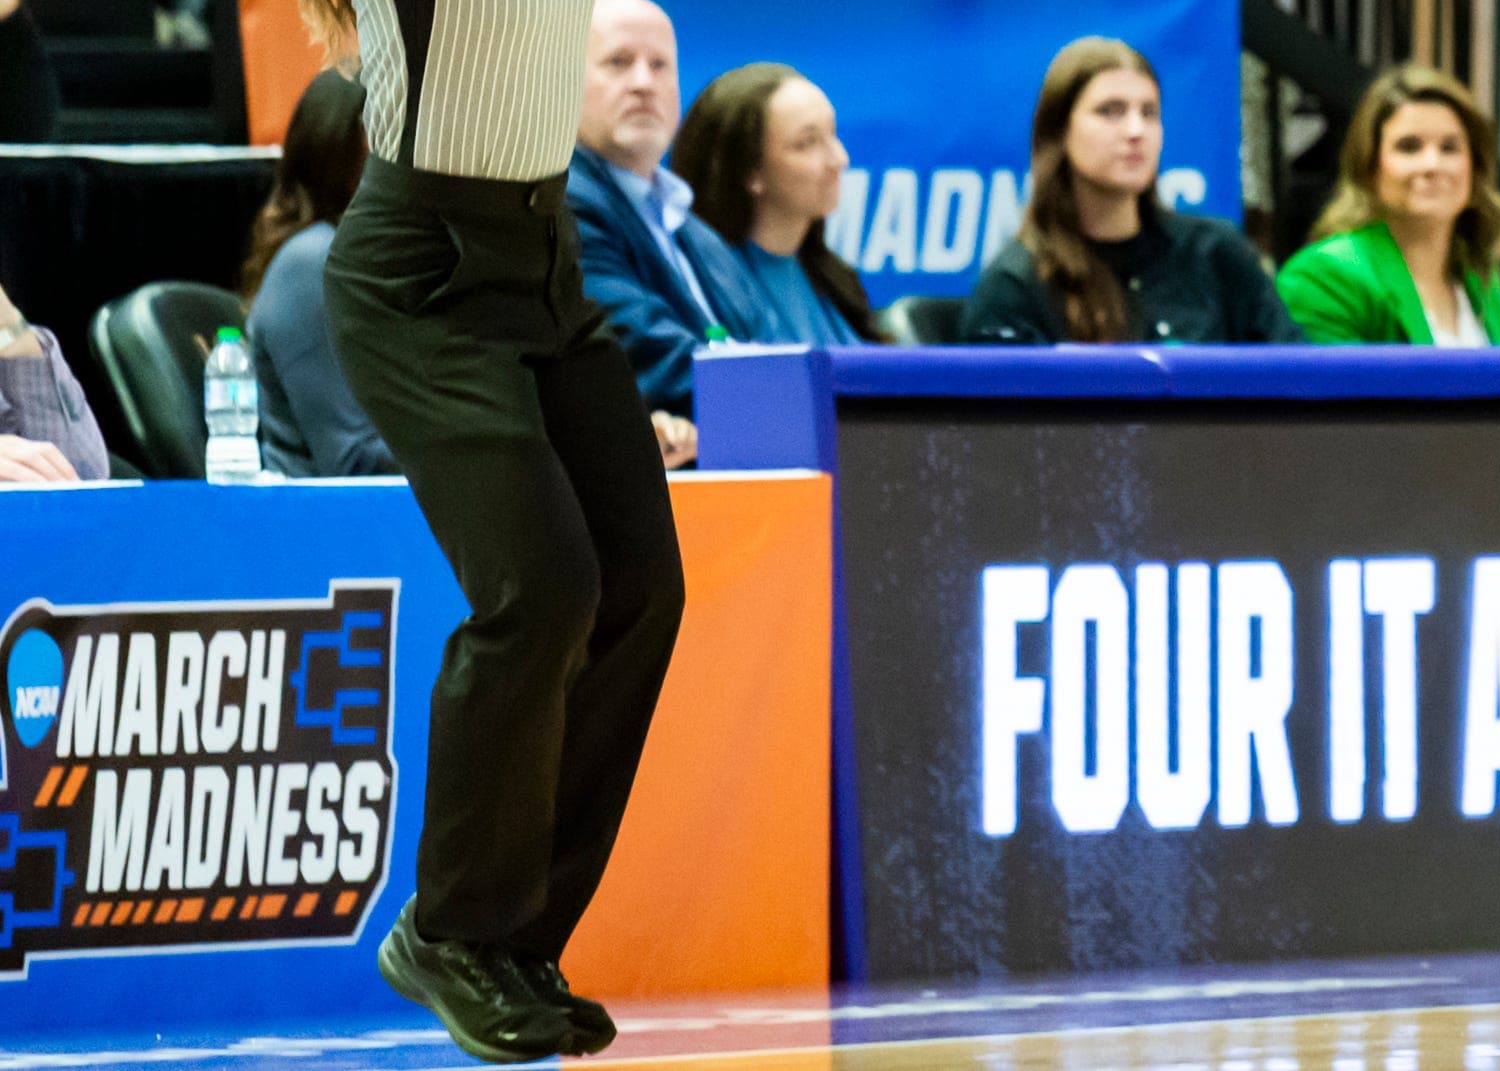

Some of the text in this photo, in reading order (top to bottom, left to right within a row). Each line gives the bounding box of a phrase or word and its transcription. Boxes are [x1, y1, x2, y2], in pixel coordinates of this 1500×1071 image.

[826, 168, 1206, 274] MADN
[56, 628, 287, 758] MARCH
[980, 560, 1299, 837] FOUR
[1328, 556, 1436, 823] IT
[86, 760, 386, 893] MADNESS
